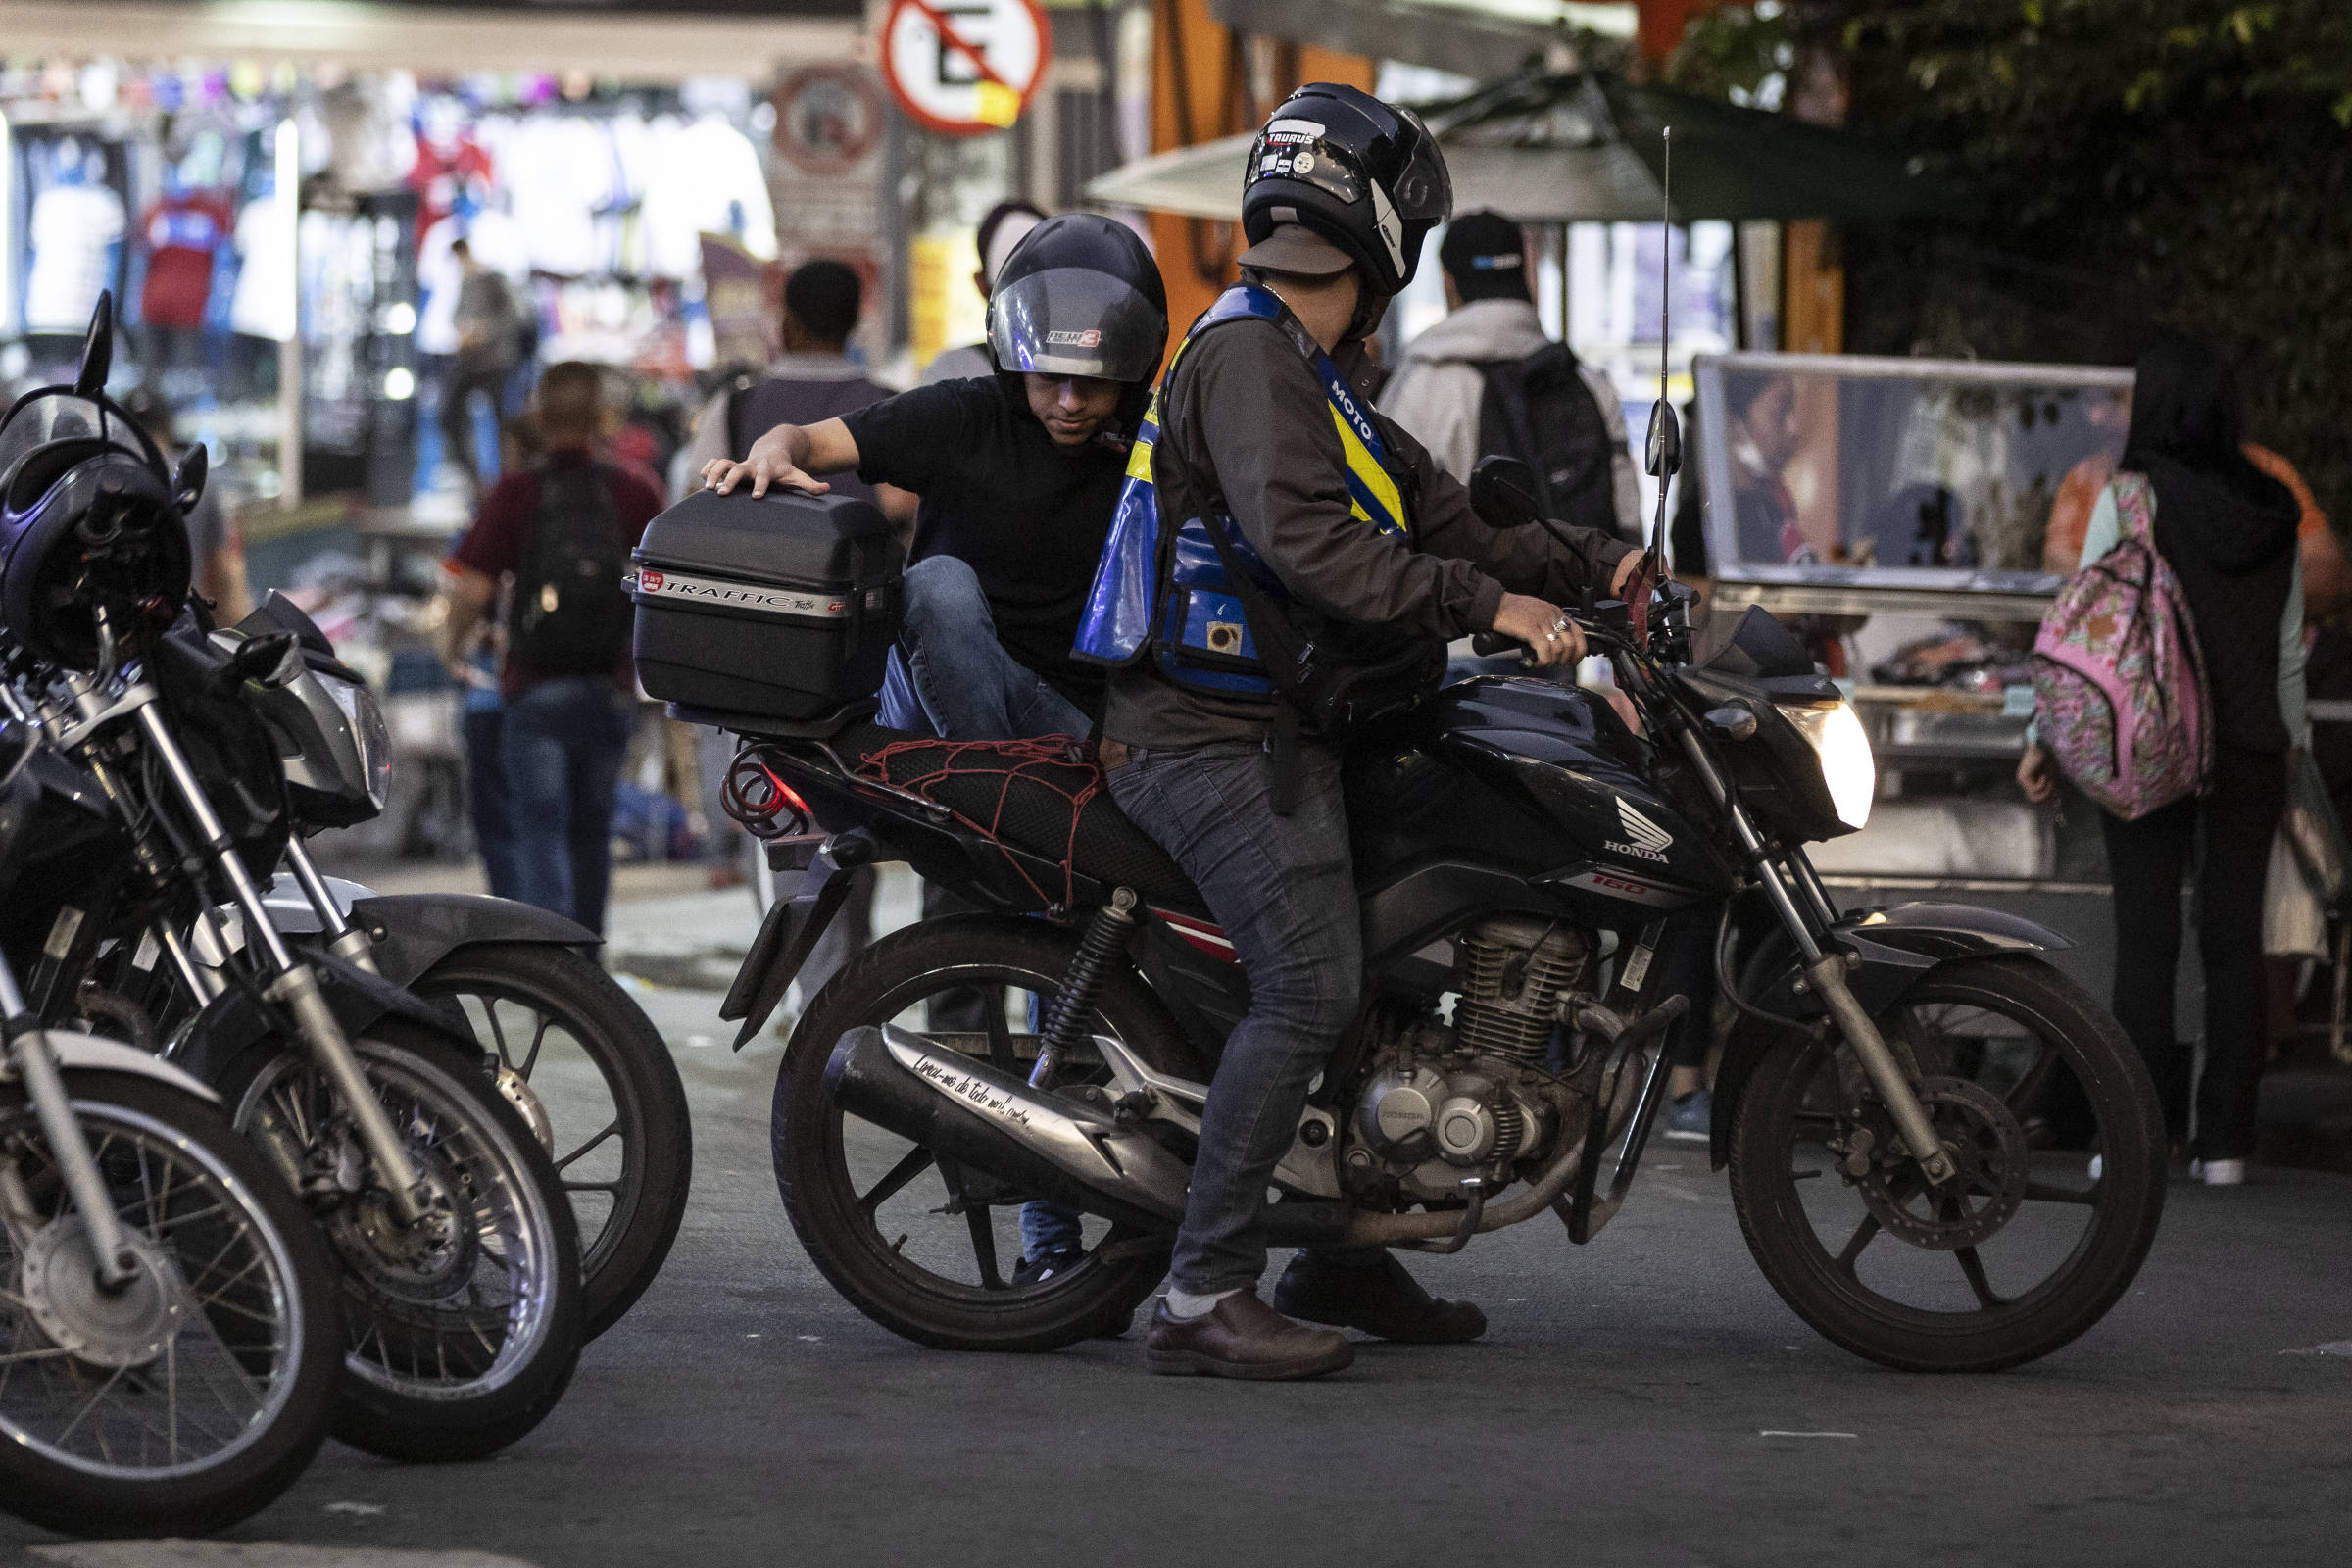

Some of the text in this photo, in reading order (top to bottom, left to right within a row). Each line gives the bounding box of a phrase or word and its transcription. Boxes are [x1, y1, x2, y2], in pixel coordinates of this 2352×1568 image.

[1268, 132, 1315, 145] TAURUS
[1331, 379, 1373, 440] MOTO
[666, 581, 792, 608] TRAFFIC
[1603, 839, 1670, 864] HONDA
[1592, 875, 1647, 895] 160
[956, 1076, 972, 1095] de
